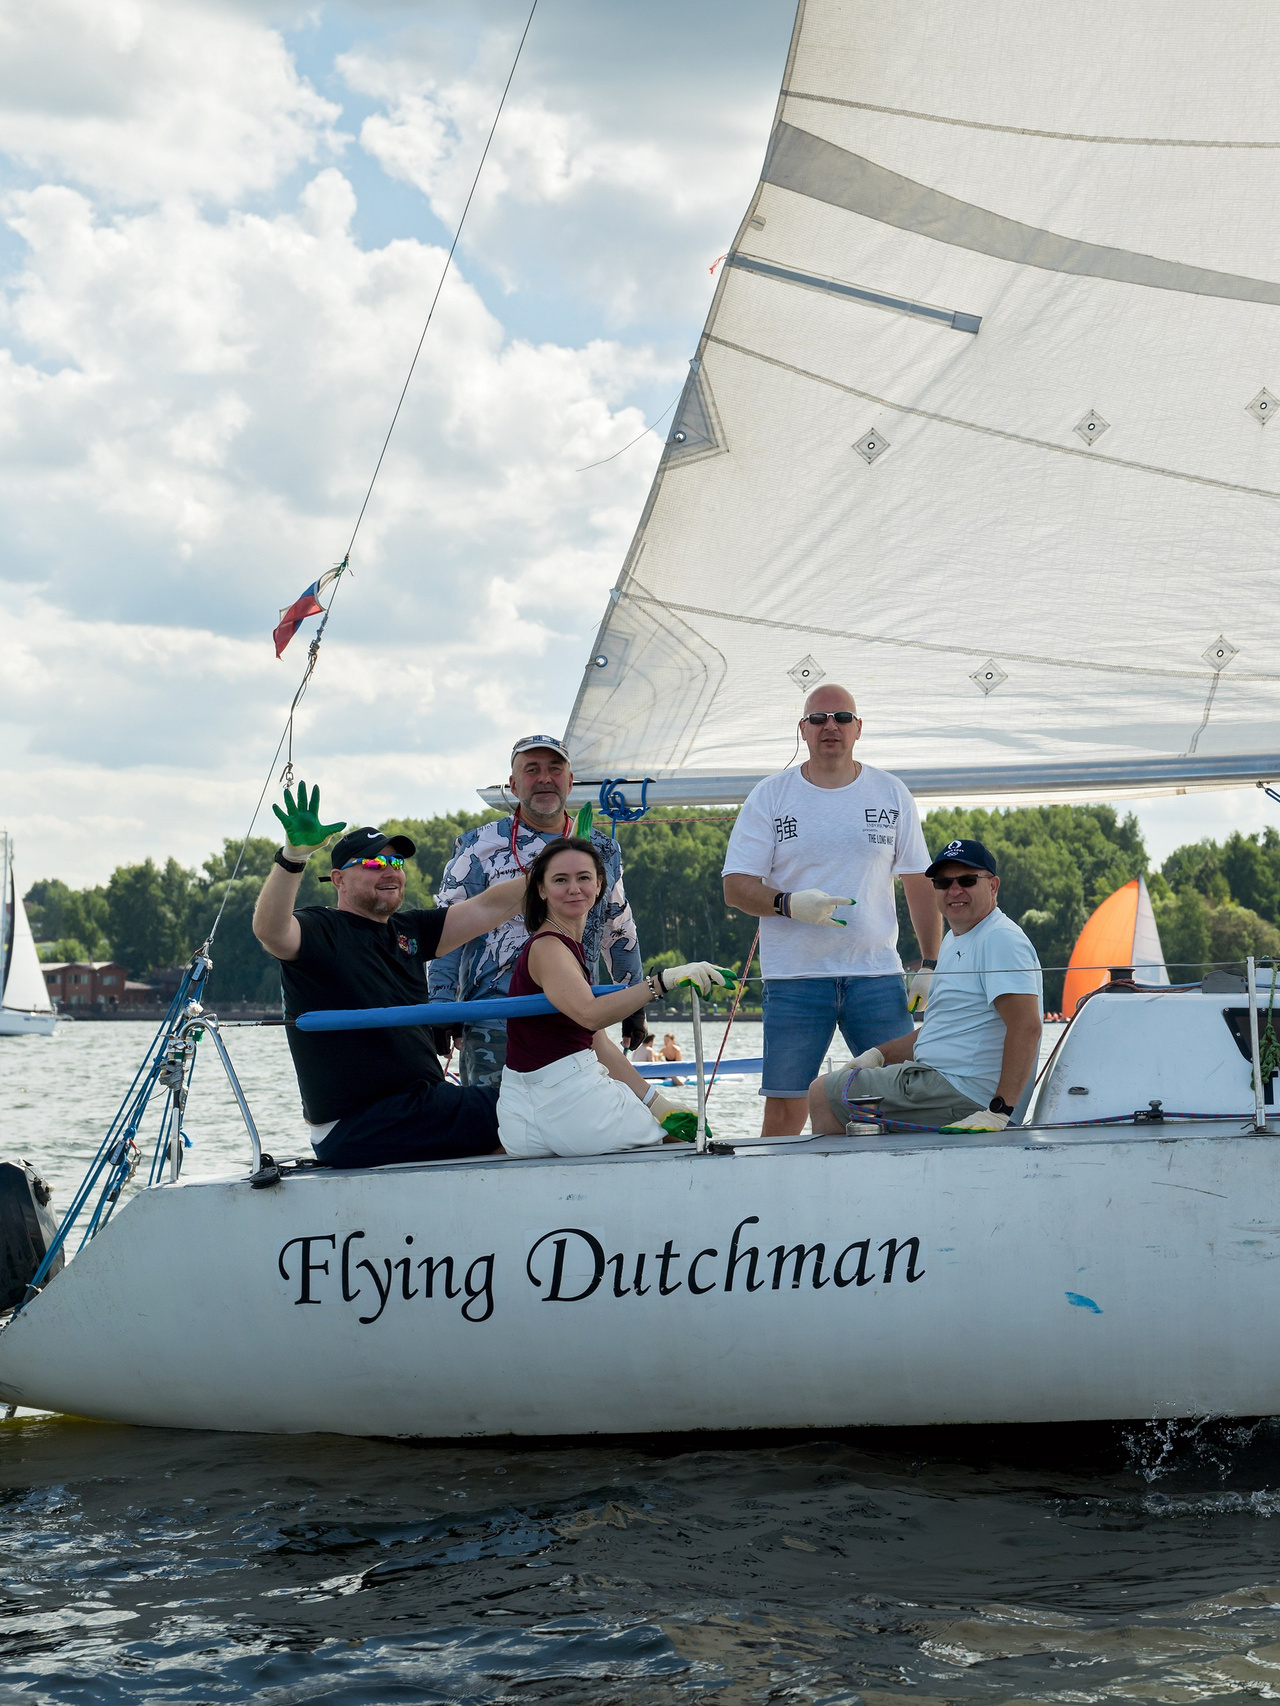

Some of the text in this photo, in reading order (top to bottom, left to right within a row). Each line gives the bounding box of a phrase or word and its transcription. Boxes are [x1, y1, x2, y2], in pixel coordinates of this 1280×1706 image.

[865, 808, 899, 824] EA7
[279, 1216, 925, 1324] Flying Dutchman
